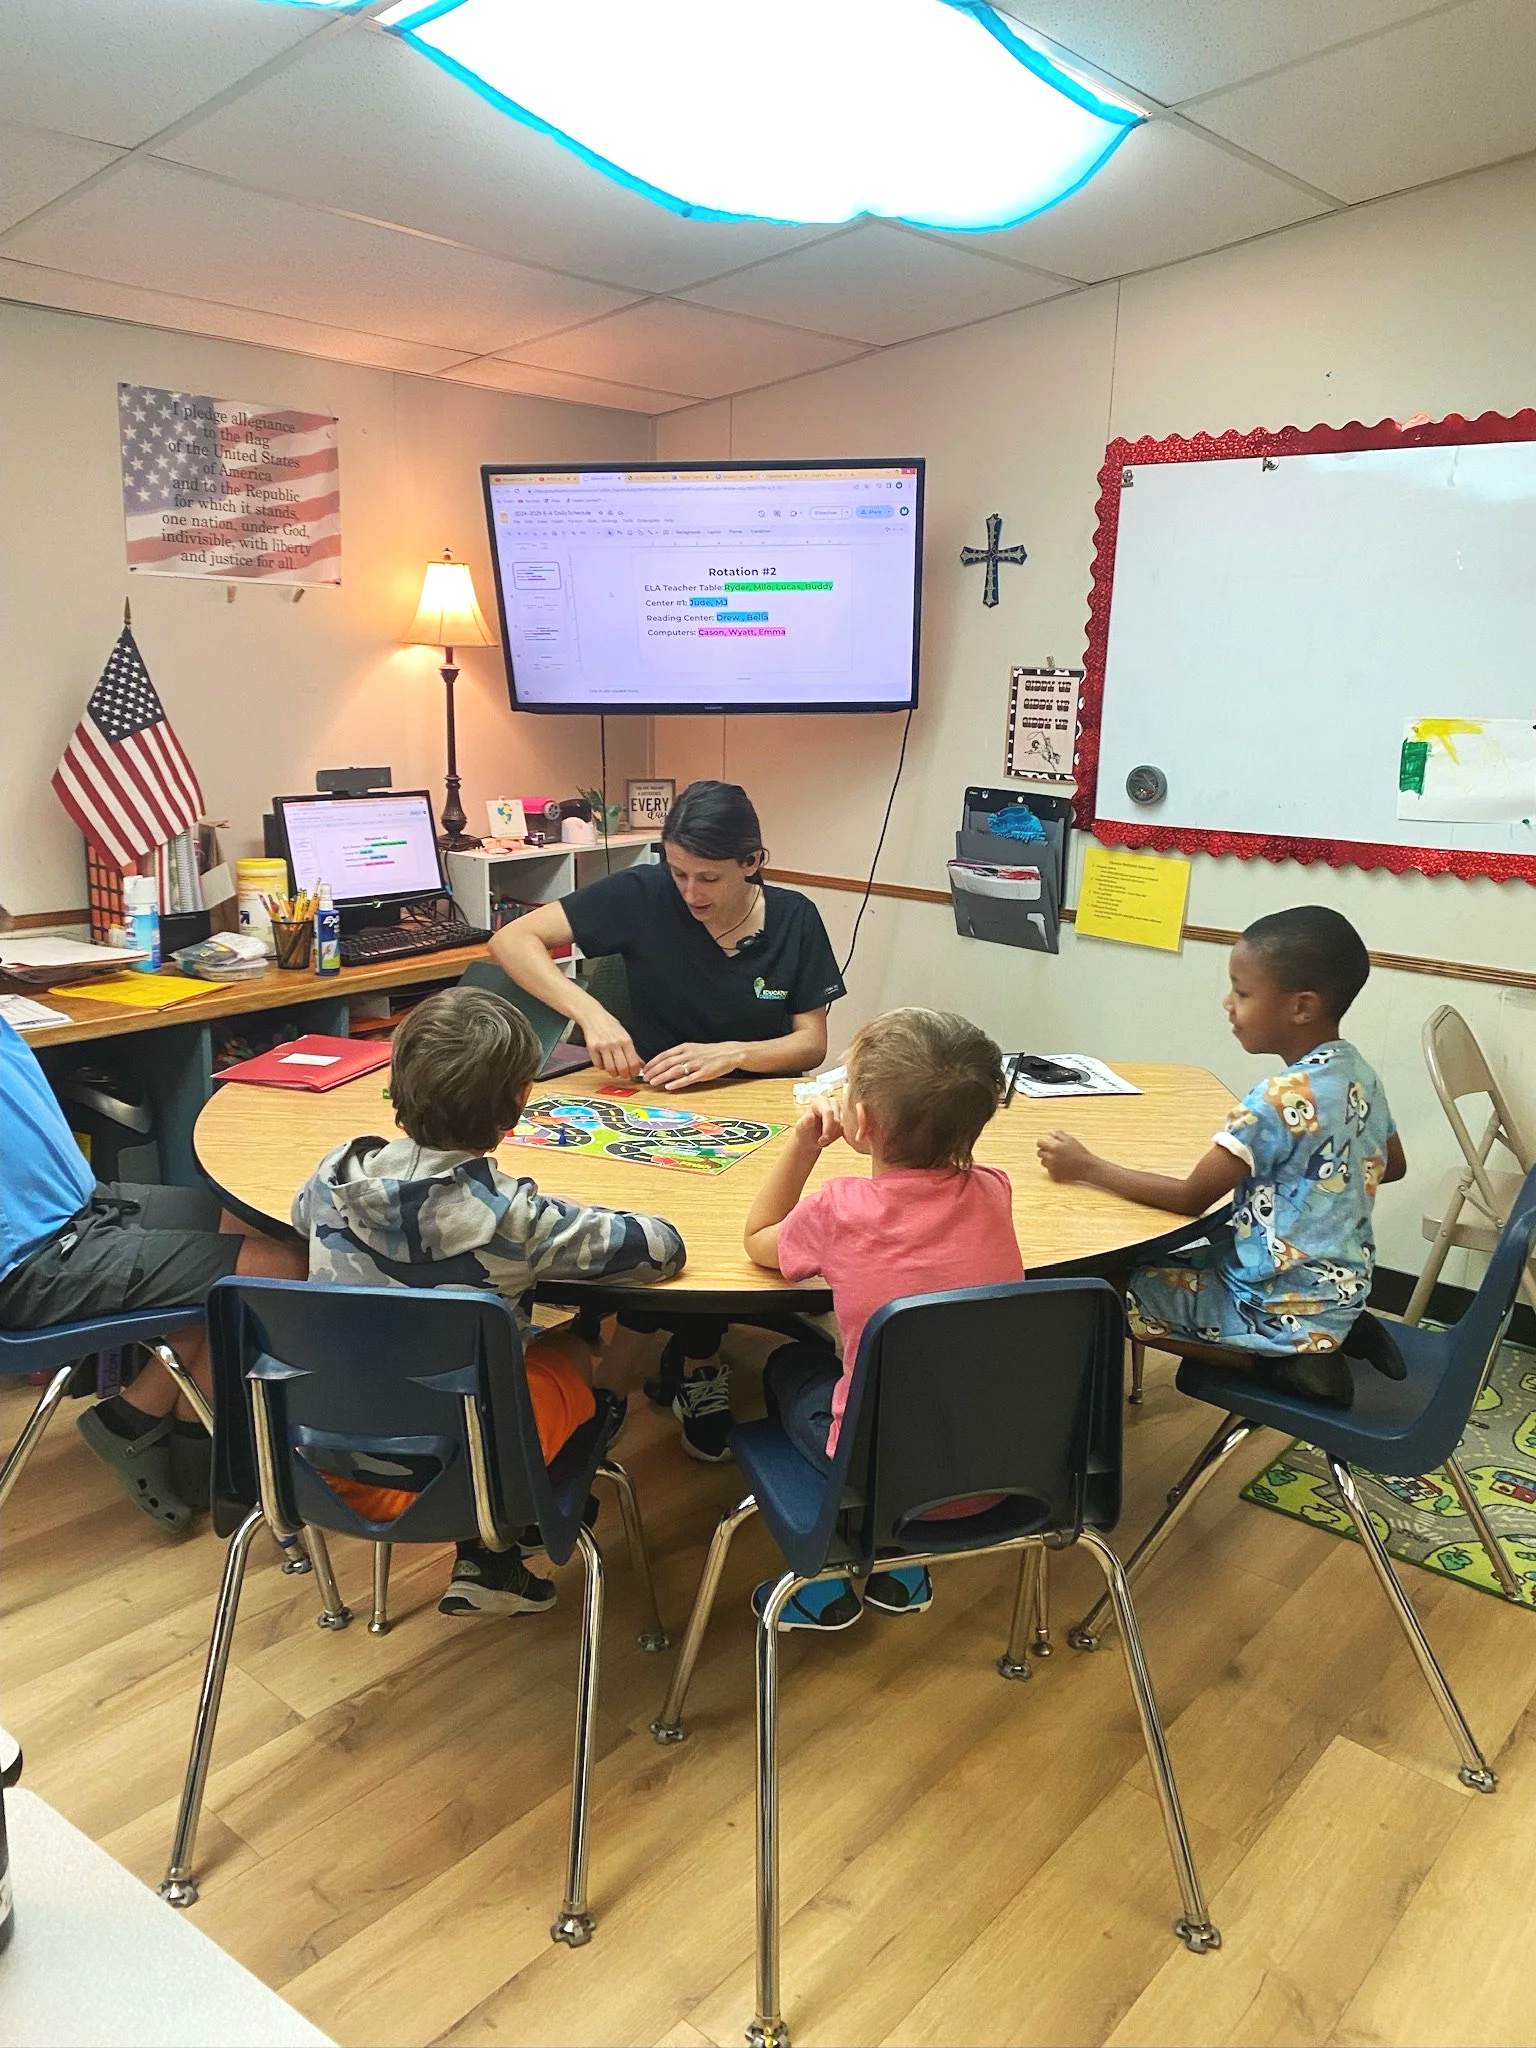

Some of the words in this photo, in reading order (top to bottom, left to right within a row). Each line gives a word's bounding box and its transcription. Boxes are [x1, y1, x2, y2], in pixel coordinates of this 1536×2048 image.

[184, 405, 227, 423] pledge
[232, 413, 296, 433] allegiance
[204, 427, 217, 439] to
[221, 430, 240, 443] the
[245, 432, 270, 449] flag
[169, 440, 184, 453] of
[187, 442, 208, 456] the
[214, 446, 257, 463] United
[262, 453, 300, 468] States
[203, 463, 217, 475] of
[219, 465, 272, 482] America
[173, 477, 198, 491] and
[204, 479, 217, 492] to
[221, 482, 240, 496] the
[246, 484, 299, 503] Republic
[175, 494, 193, 508] for
[198, 498, 236, 513] which
[241, 502, 250, 514] it
[256, 505, 299, 520] stands,
[162, 514, 187, 526] one
[192, 516, 238, 532] nation,
[242, 521, 279, 535] under
[283, 523, 310, 539] God,
[161, 529, 235, 548] indivisible,
[239, 537, 268, 551] with
[272, 537, 312, 557] liberty
[180, 549, 206, 564] and
[210, 552, 253, 569] justice
[257, 555, 276, 567] for
[278, 557, 297, 570] all.
[709, 567, 759, 576] Rotation
[762, 567, 776, 576] #2
[806, 583, 833, 591] Buddy
[647, 615, 681, 623] Reading
[684, 614, 714, 622] Center:
[747, 613, 768, 621] Bella
[648, 629, 696, 637] Computers:
[1025, 680, 1055, 692] GIDDY
[1058, 681, 1071, 692] UP
[1024, 698, 1053, 710] GIDDY
[1056, 700, 1070, 712] UP
[1023, 717, 1052, 729] GIDDY
[1055, 719, 1068, 730] UP
[631, 798, 669, 811] EVERY
